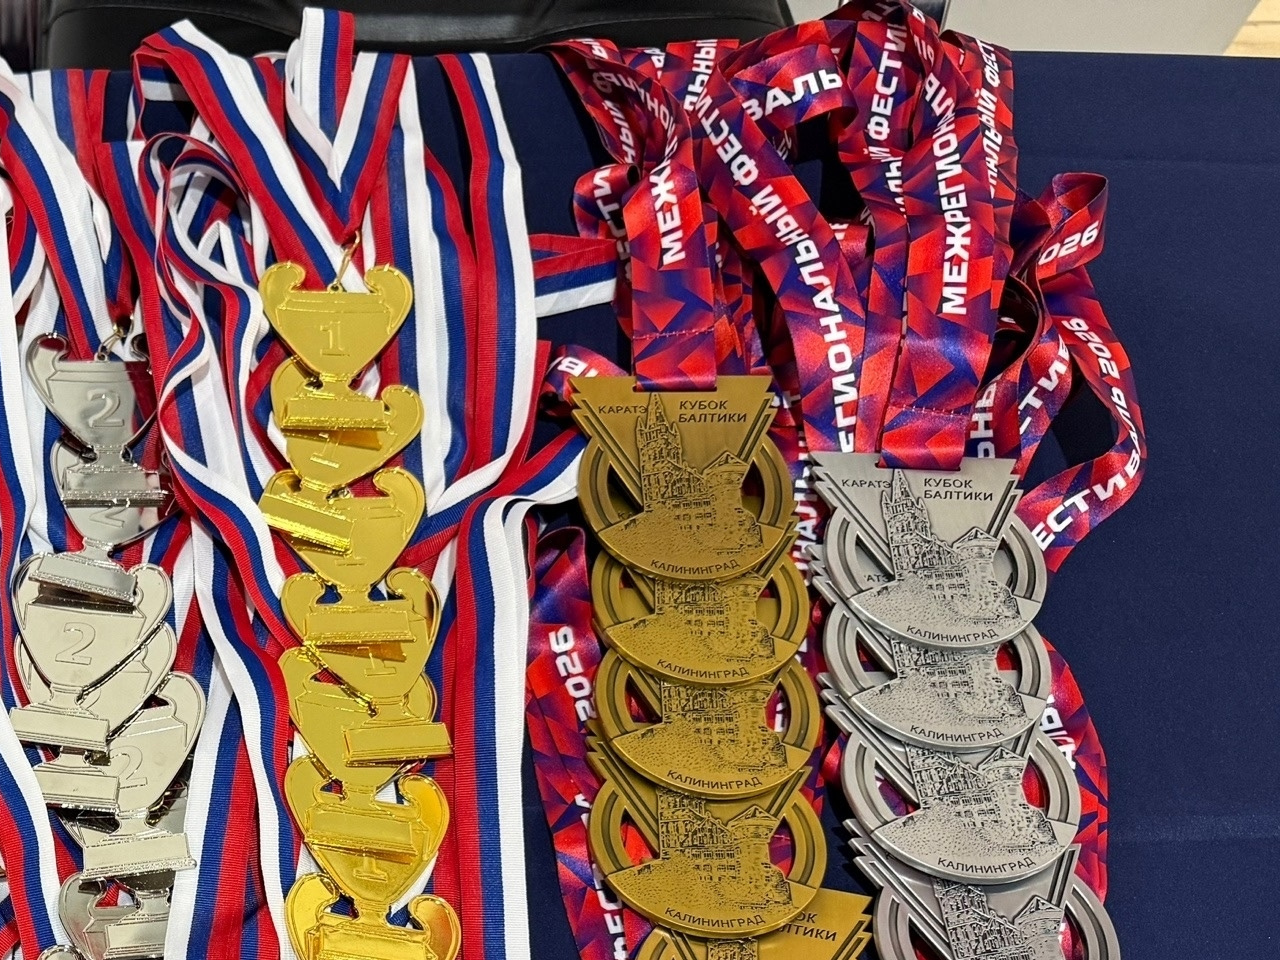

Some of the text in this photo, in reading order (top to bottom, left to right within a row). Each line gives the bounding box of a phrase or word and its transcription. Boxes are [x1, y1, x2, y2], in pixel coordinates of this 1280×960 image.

[320, 321, 350, 356] 1
[87, 390, 125, 427] 2
[598, 405, 647, 414] КАРАТЭ
[679, 400, 728, 410] КУБОК
[678, 412, 747, 423] БАЛТИКИ
[841, 478, 891, 488] КАРАТЭ
[924, 478, 973, 489] КУБОК
[923, 490, 993, 501] БАЛТИКИ
[651, 559, 741, 575] КАЛИНИНГРАД
[907, 625, 999, 643] КАЛИНИНГРАД
[55, 622, 96, 665] 2
[656, 658, 750, 680] КАЛИНИНГРАД
[910, 724, 1005, 742] КАЛИНИНГРАД
[667, 769, 763, 791] КАЛИНИНГРАД
[937, 856, 1036, 874] КАЛИНИНГРАД
[664, 906, 766, 929] КАЛИНИНГРАД
